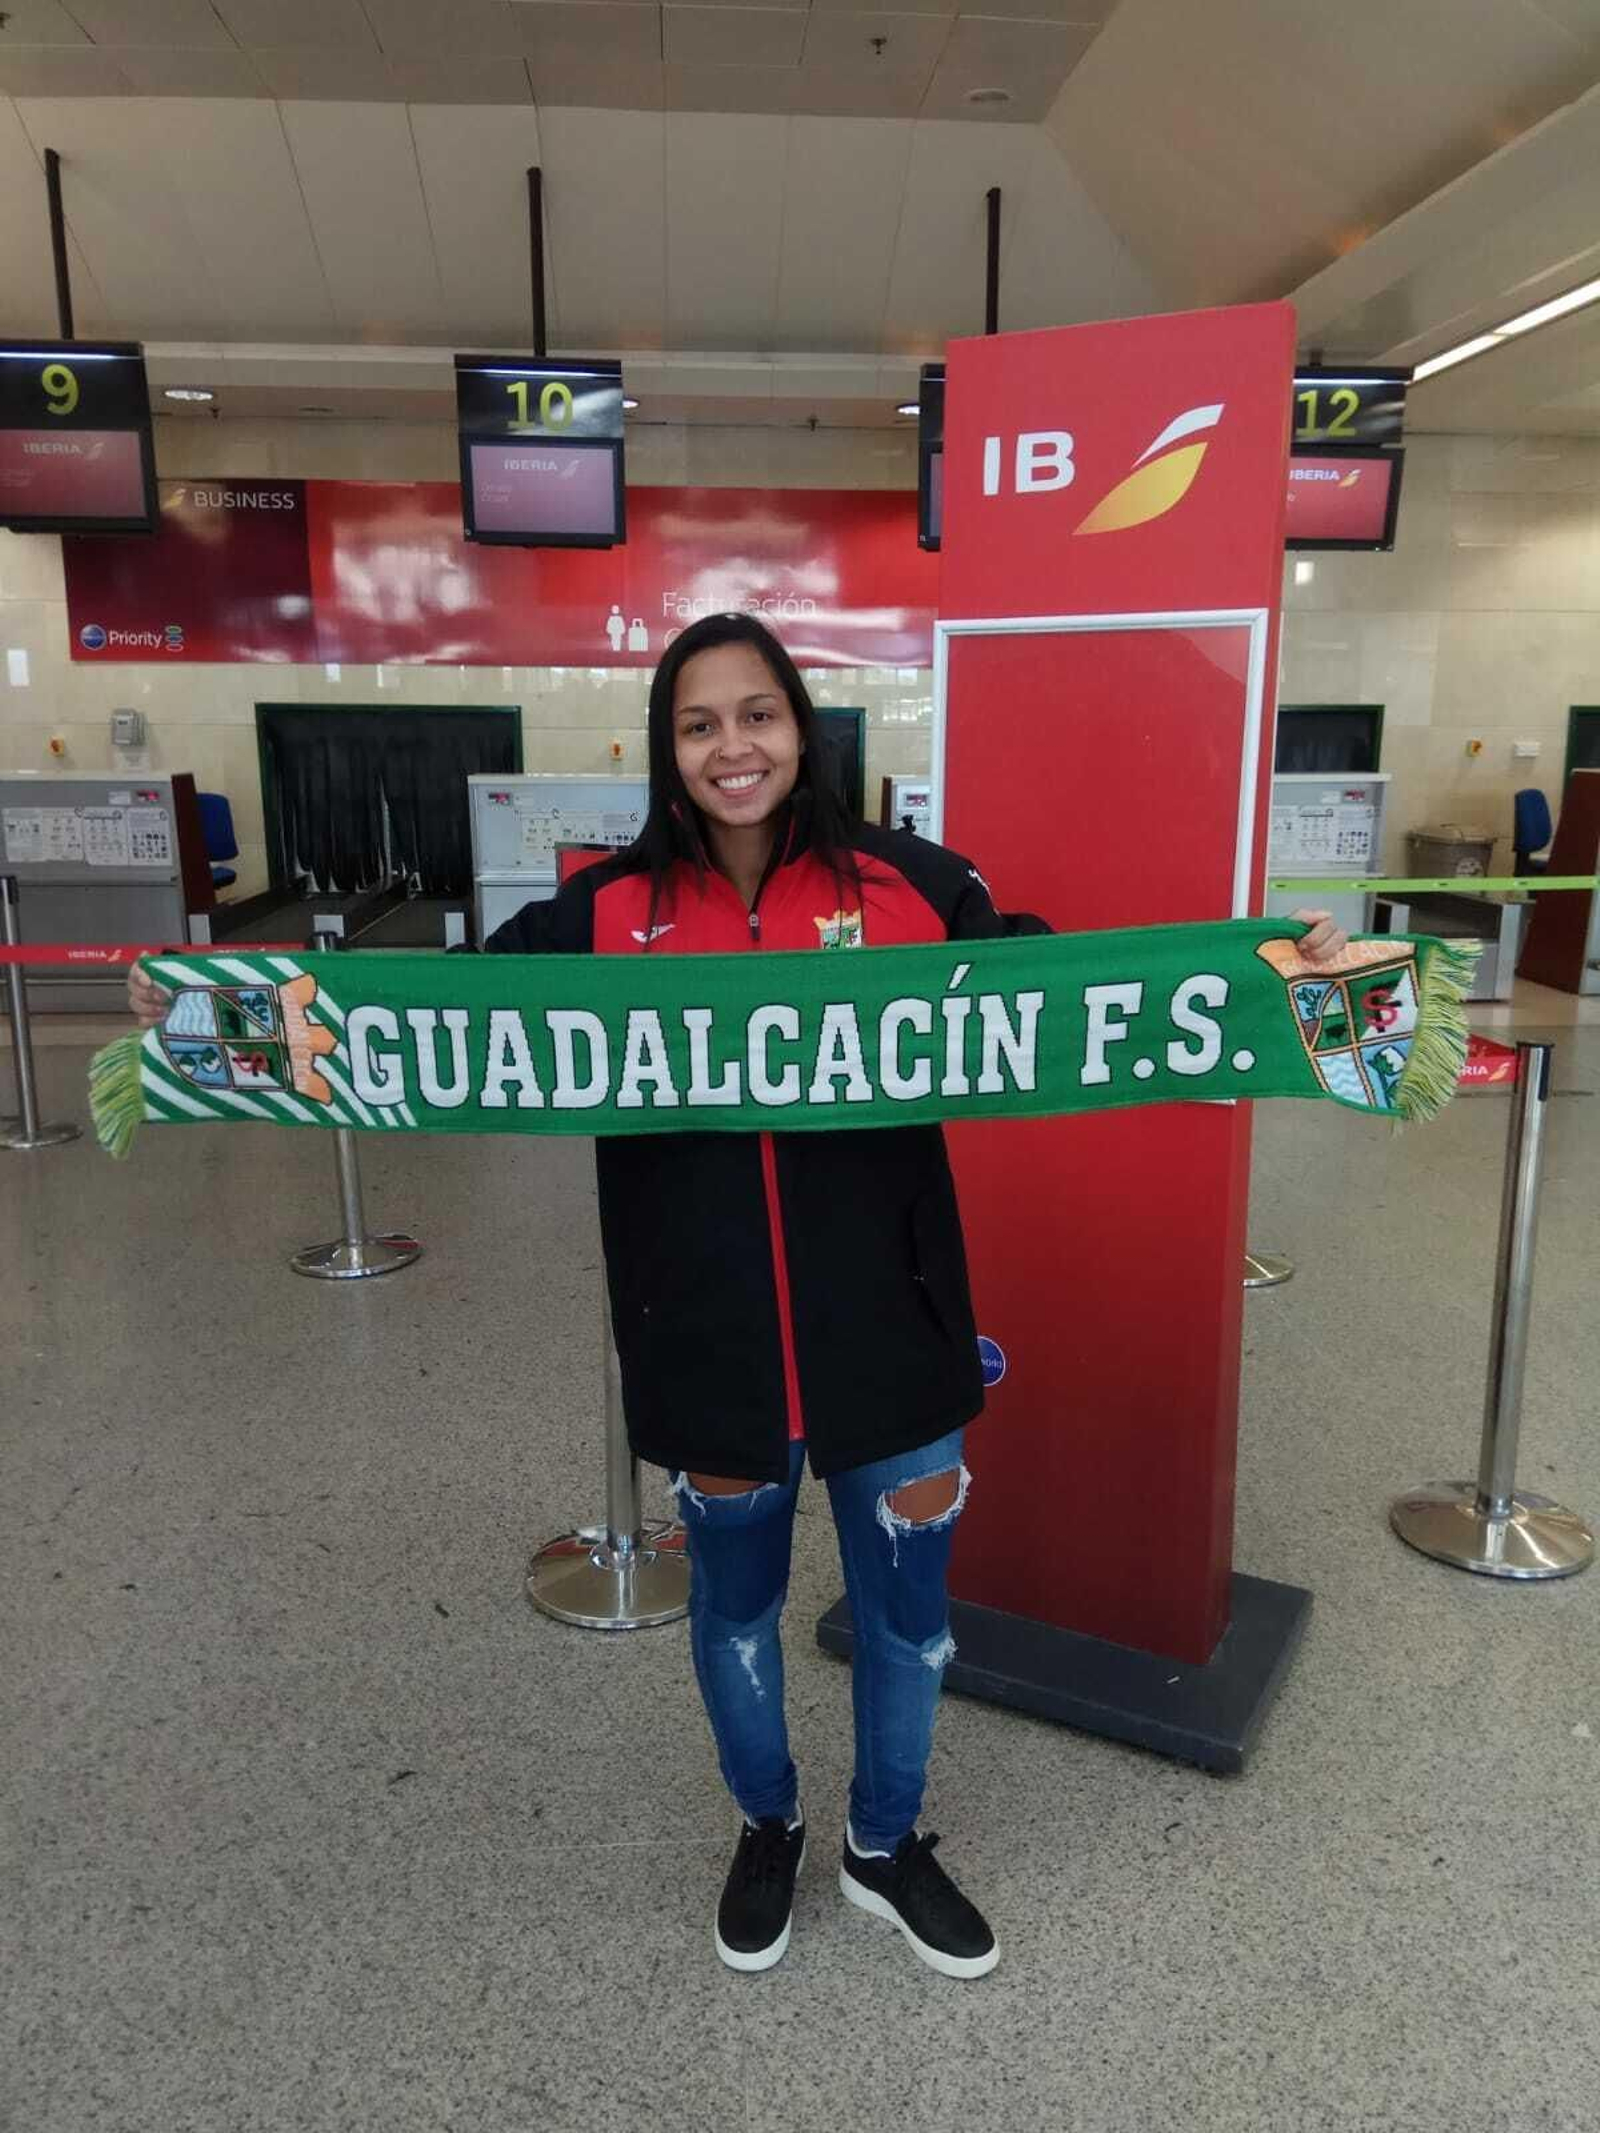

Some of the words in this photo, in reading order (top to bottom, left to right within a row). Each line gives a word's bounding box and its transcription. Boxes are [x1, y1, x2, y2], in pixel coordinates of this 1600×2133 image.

[41, 363, 79, 415] 9
[507, 381, 574, 431] 10
[1296, 388, 1360, 437] 12
[983, 430, 1075, 496] IB
[1289, 468, 1340, 480] IBERIA
[194, 491, 295, 510] BUSINESS
[109, 631, 162, 649] Priority
[346, 964, 1045, 1108] GUADALCACÍN
[1080, 973, 1256, 1086] F.S.
